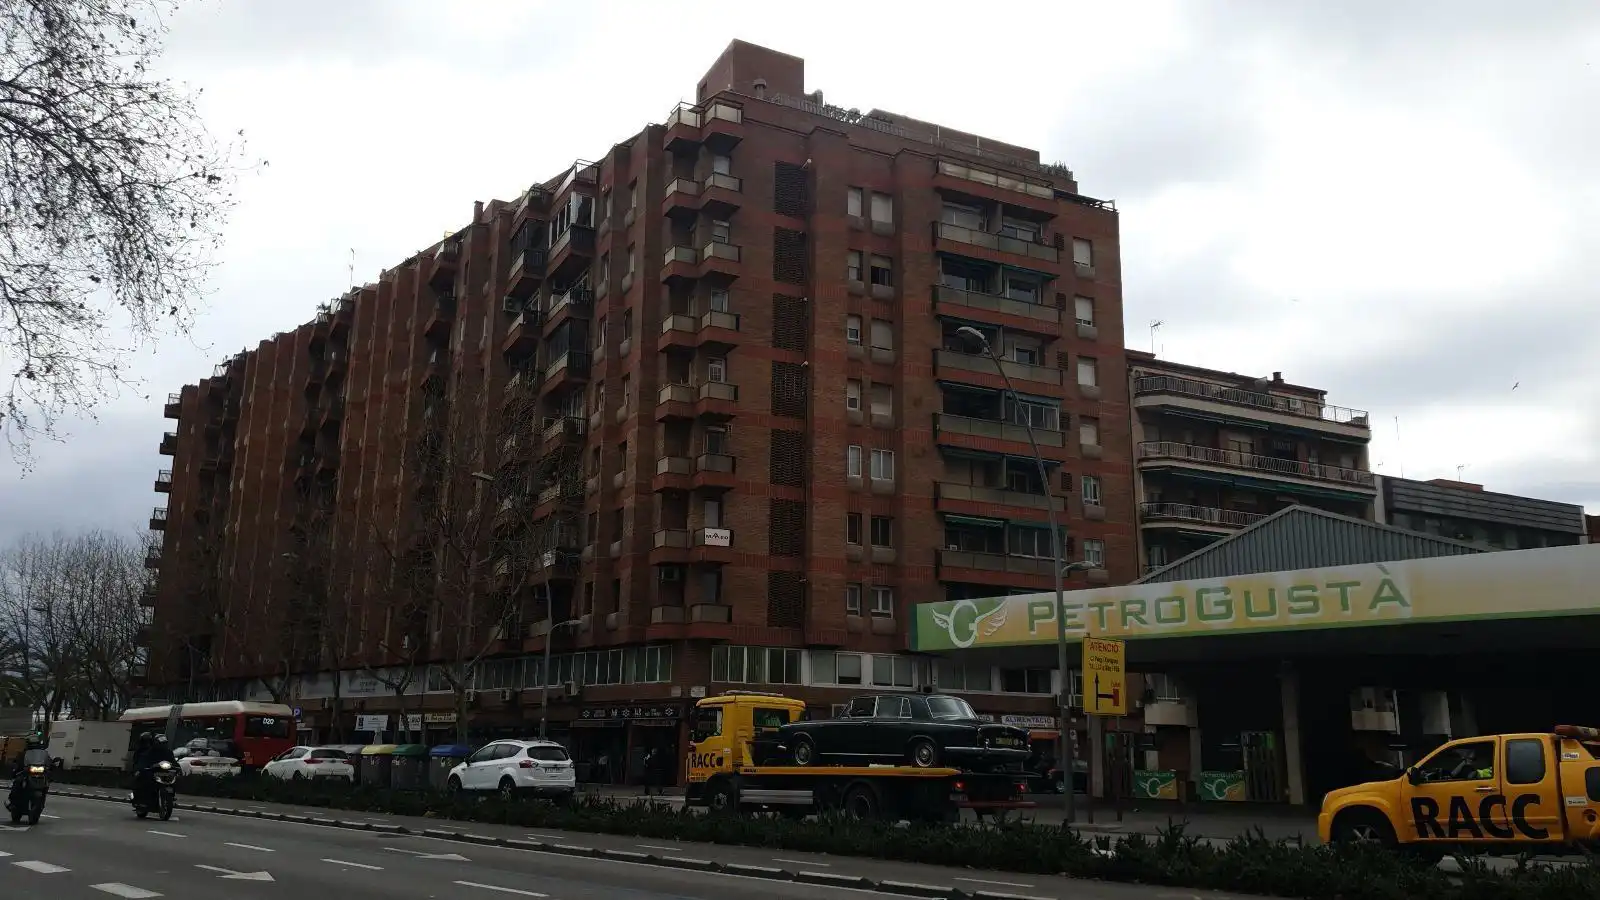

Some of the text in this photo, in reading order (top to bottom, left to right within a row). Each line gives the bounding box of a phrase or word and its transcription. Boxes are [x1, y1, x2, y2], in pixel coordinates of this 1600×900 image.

[1028, 563, 1411, 634] PETROGUSTÀ
[692, 752, 716, 768] RACC
[1411, 793, 1550, 840] RACC
